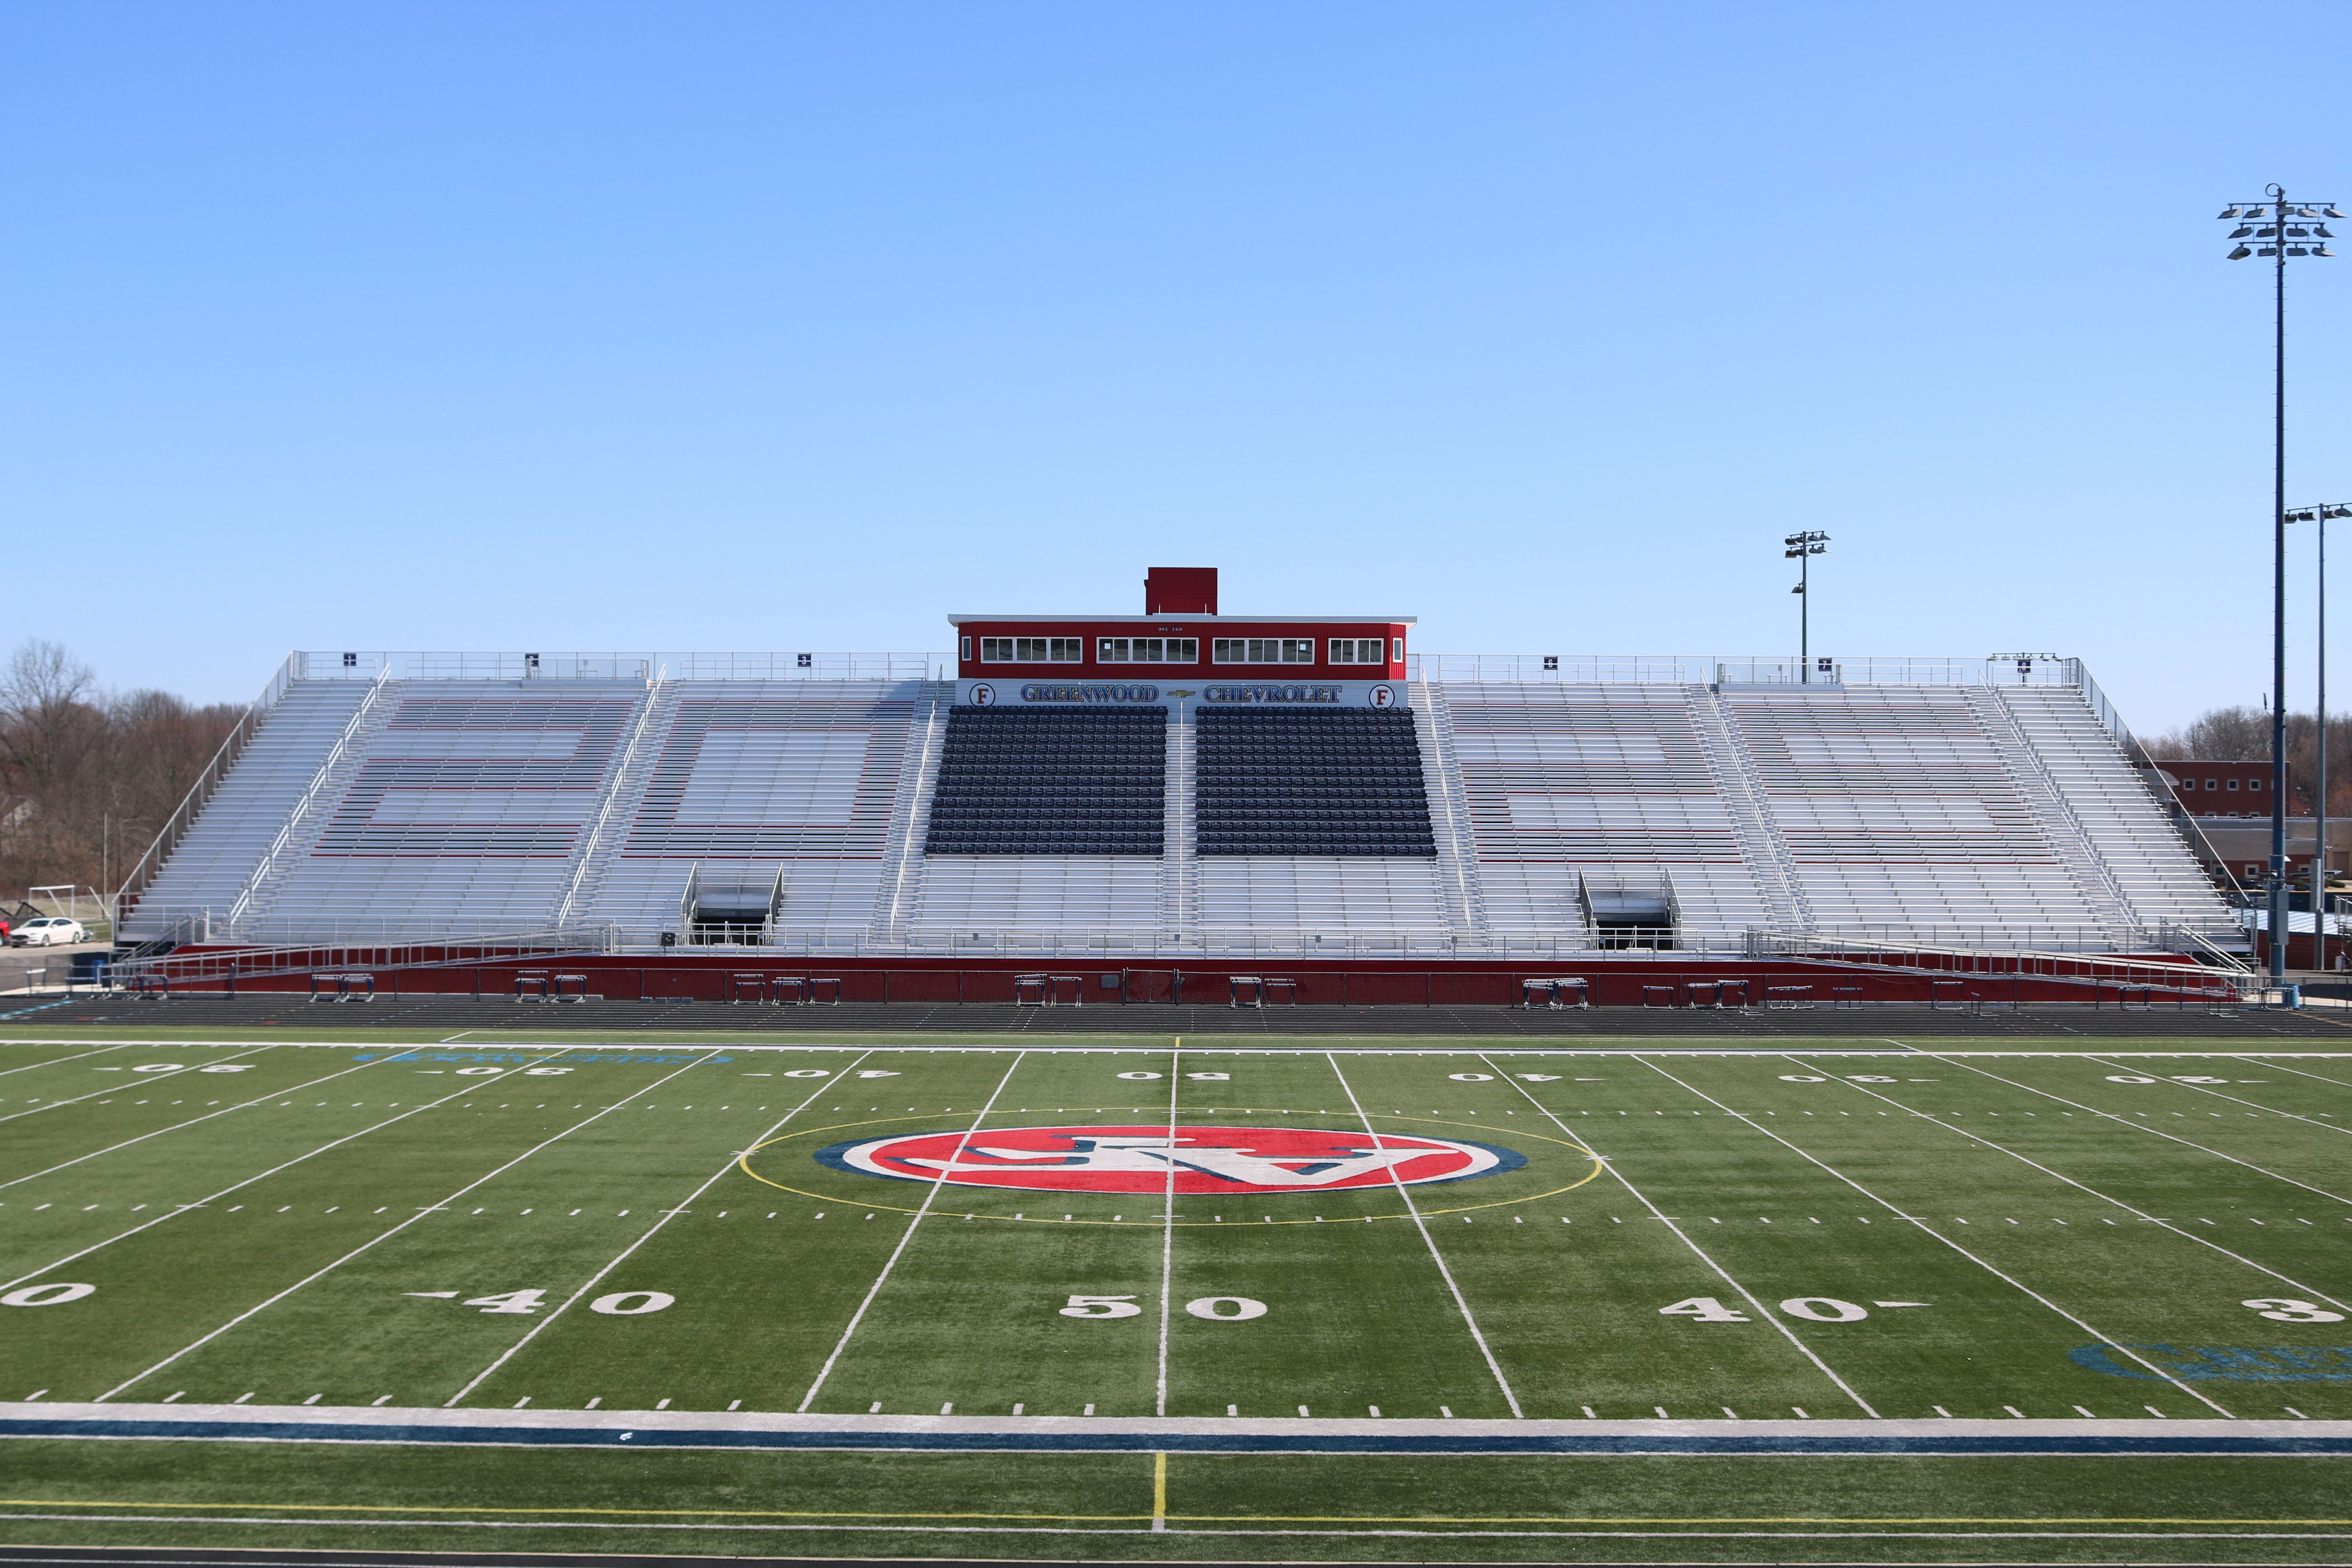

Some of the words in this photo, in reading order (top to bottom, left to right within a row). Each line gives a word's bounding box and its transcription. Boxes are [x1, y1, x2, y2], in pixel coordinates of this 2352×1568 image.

[802, 656, 806, 665] 3
[1548, 659, 1553, 668] 6
[1822, 661, 1827, 669] 7
[976, 688, 989, 704] F
[1021, 684, 1159, 702] GREENWOOD
[1203, 685, 1342, 703] CHEVROLET
[1376, 689, 1388, 705] F
[0, 1283, 96, 1307] 0
[2241, 1298, 2345, 1323] 3
